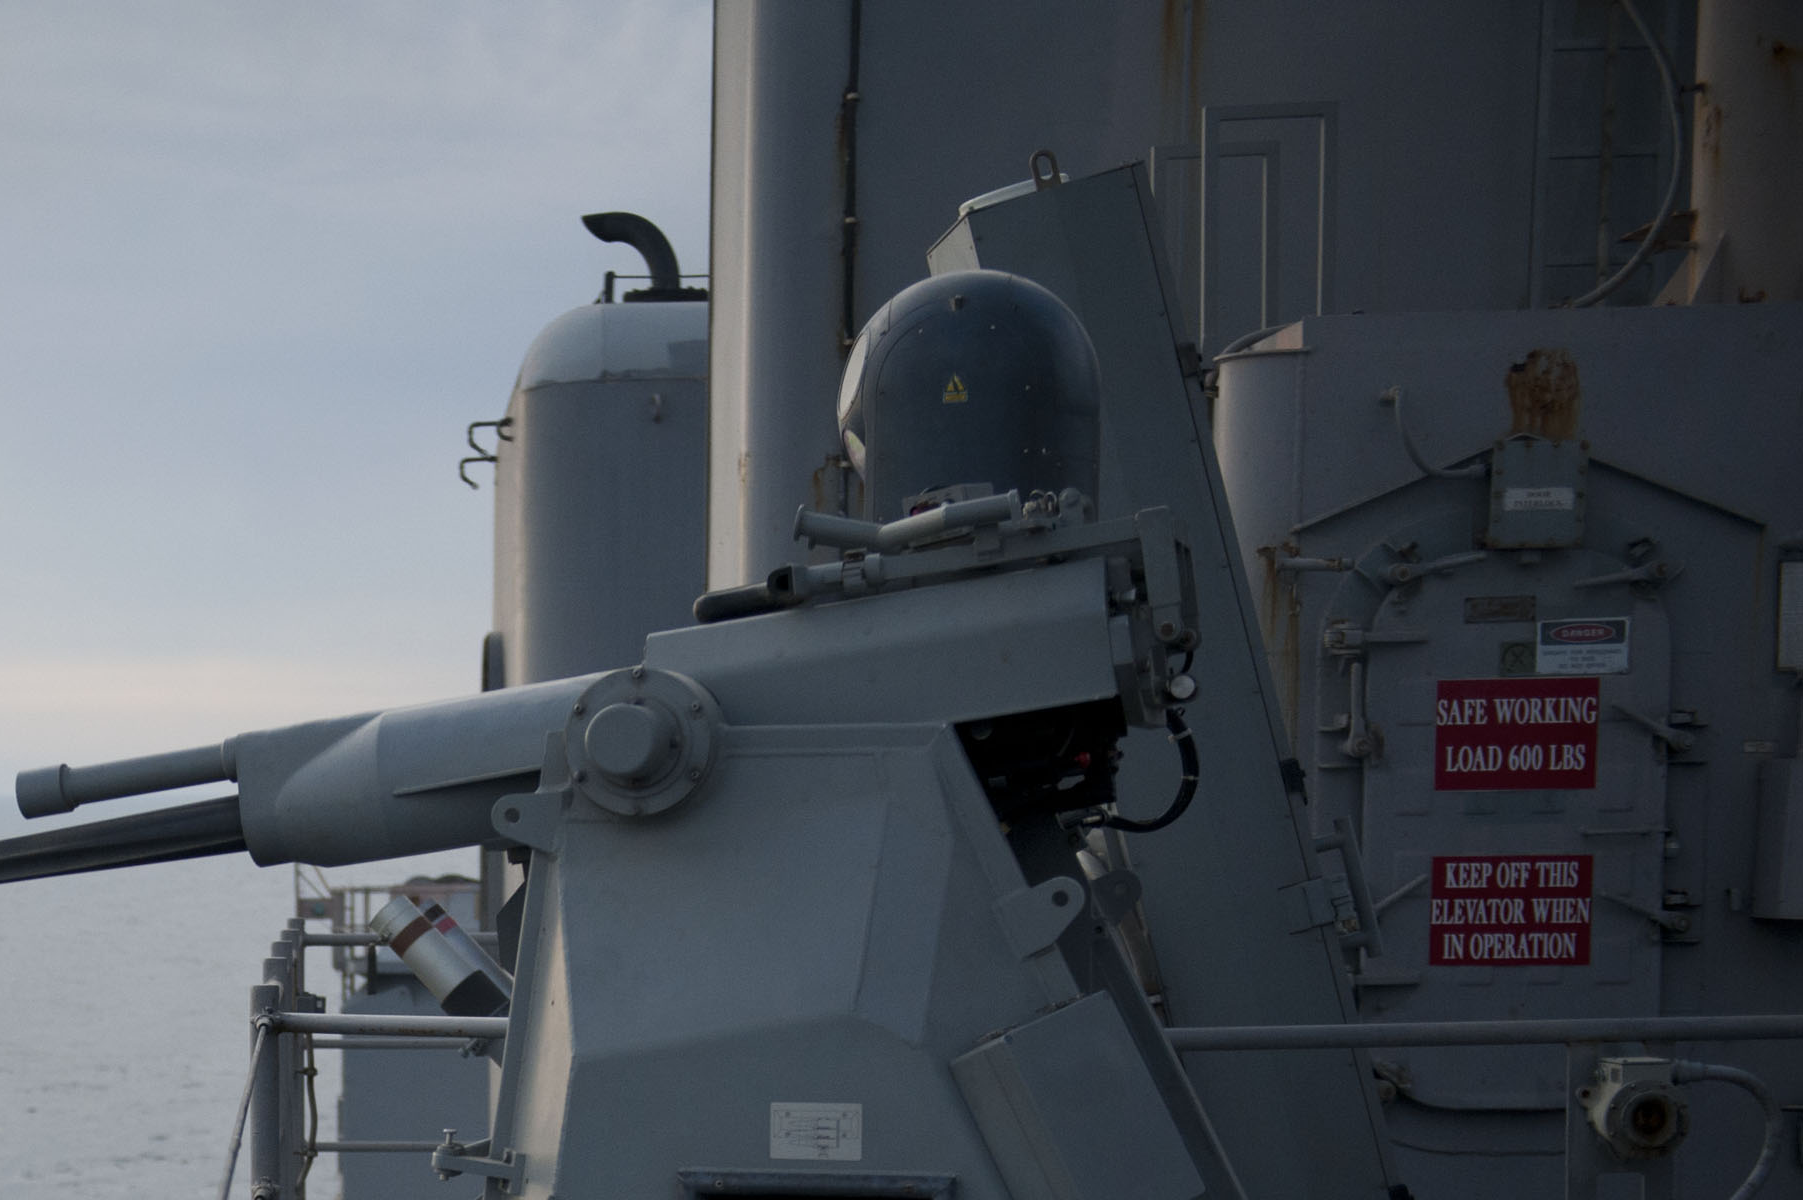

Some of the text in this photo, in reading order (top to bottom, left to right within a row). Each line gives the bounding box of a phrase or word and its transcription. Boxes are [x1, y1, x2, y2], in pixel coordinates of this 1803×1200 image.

[1561, 628, 1605, 638] DANGER
[1436, 697, 1597, 725] SAFE WORKING
[1446, 744, 1585, 772] LOAD 600 LBS
[1445, 861, 1578, 888] KEEP OFF THIS
[1431, 898, 1591, 924] ELEVATOR WHEN
[1443, 933, 1576, 959] IN OPERATION
